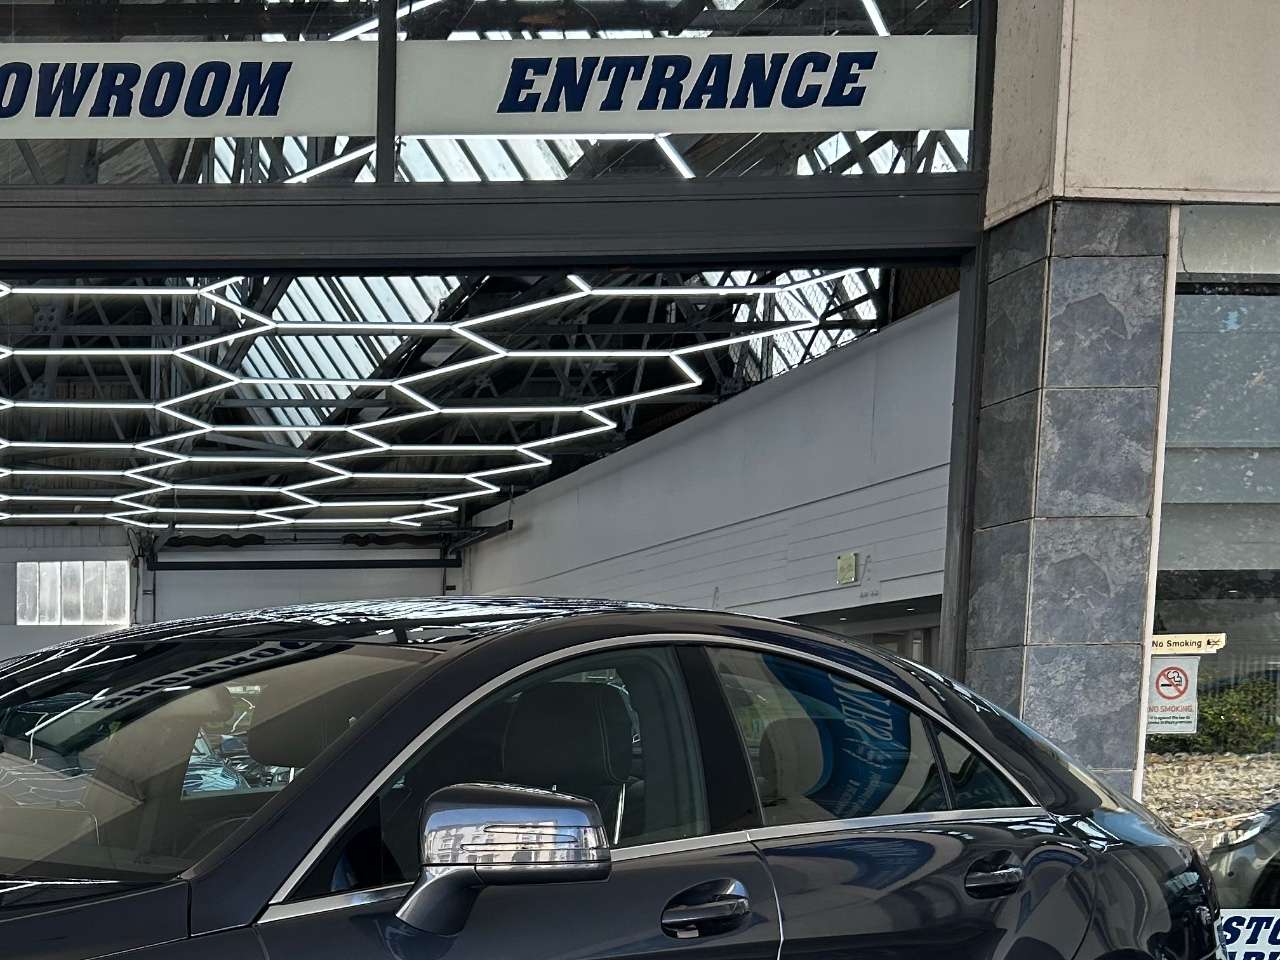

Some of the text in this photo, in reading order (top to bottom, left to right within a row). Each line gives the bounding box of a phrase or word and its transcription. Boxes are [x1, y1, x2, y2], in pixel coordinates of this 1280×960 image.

[495, 51, 879, 114] ENTRANCE
[1151, 639, 1203, 649] No Smoking
